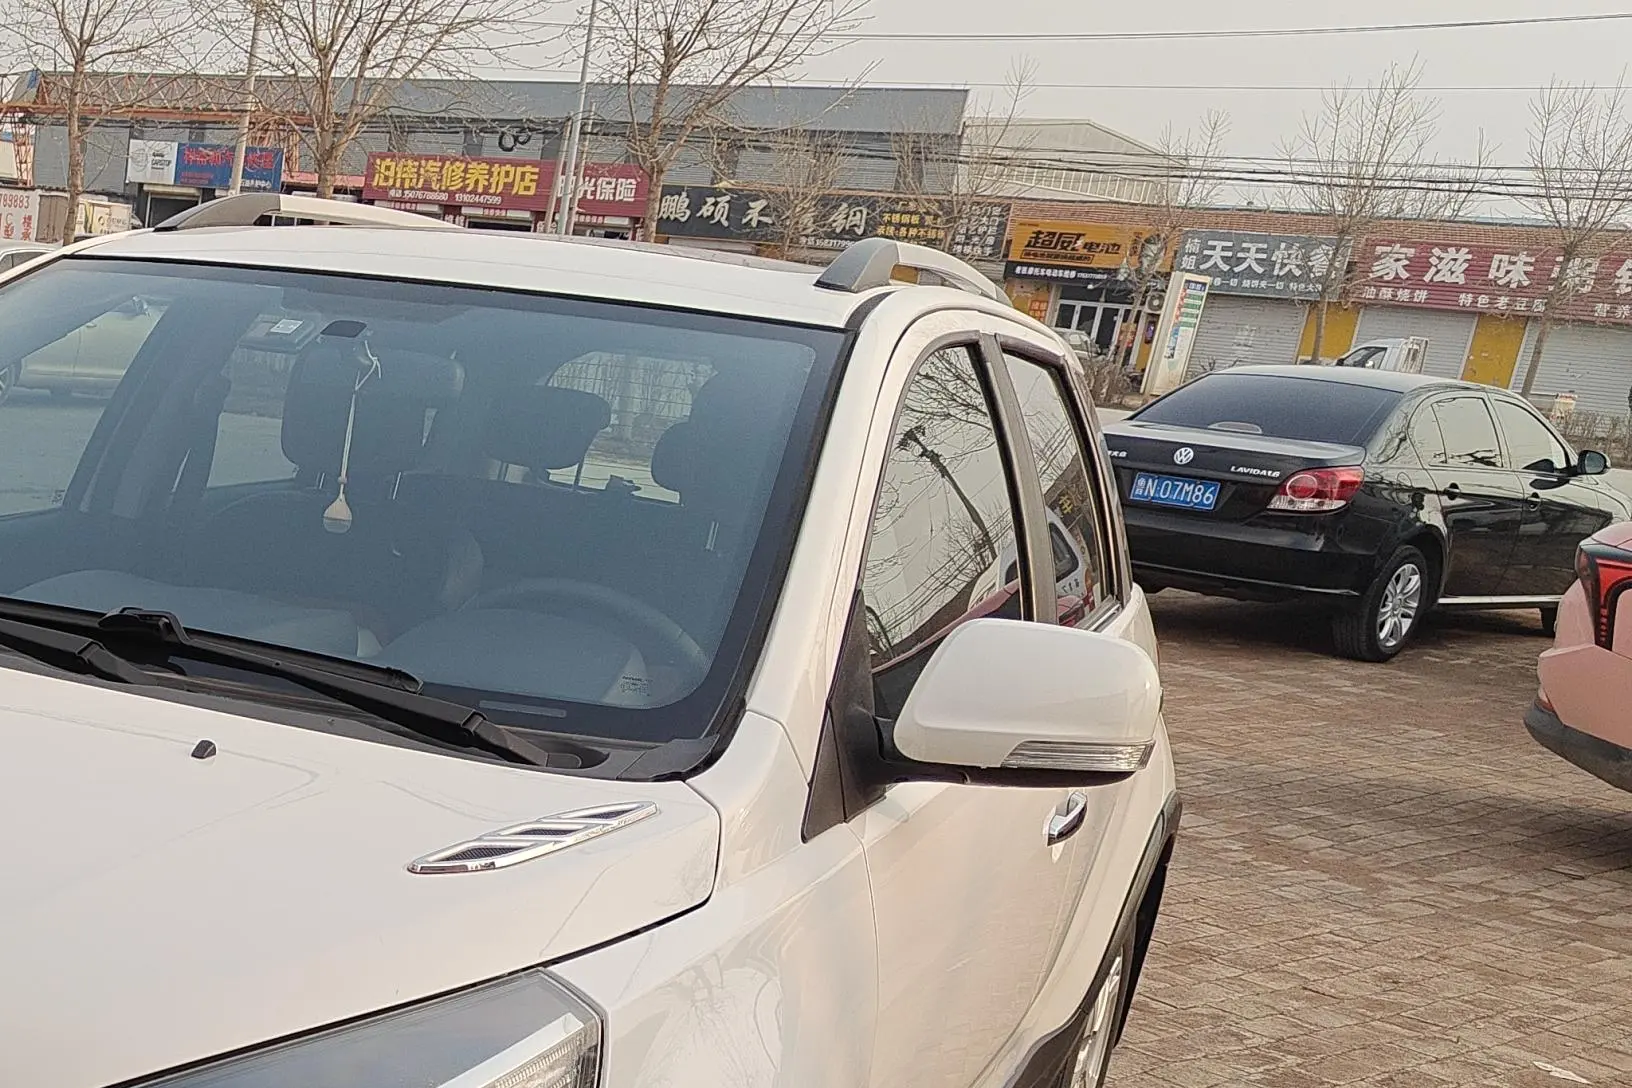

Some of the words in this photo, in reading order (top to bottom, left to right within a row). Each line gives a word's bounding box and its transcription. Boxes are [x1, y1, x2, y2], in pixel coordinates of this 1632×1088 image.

[1024, 230, 1121, 255] 超威电池
[1362, 286, 1428, 304] 油酥烧饼
[1458, 292, 1548, 313] 特色老豆腐
